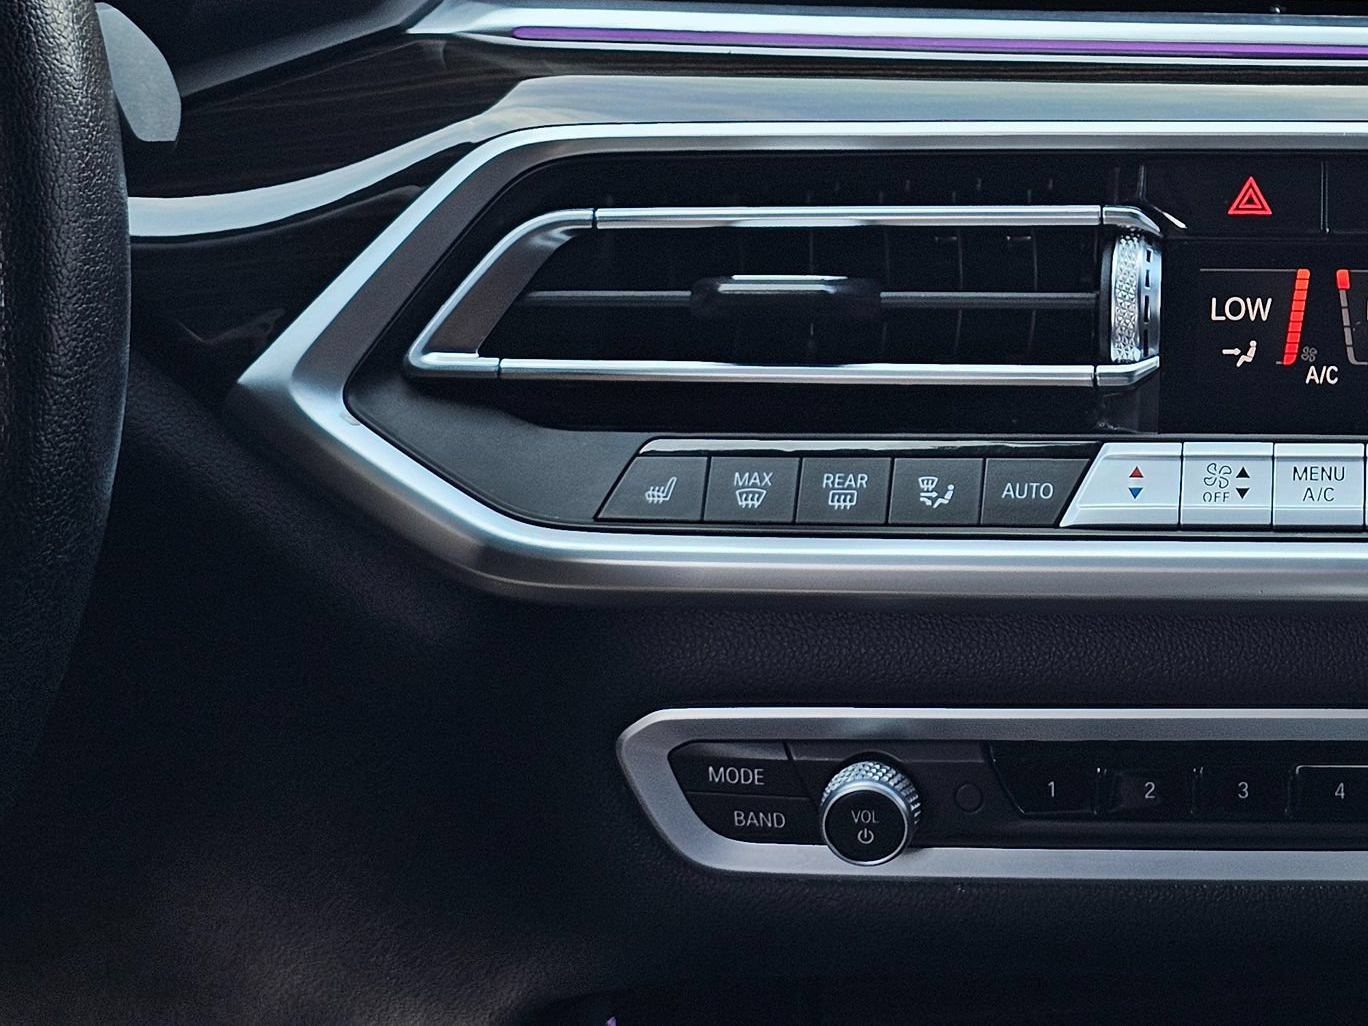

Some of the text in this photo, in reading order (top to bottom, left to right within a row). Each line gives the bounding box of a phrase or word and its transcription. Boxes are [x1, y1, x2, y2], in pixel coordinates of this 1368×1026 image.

[1210, 297, 1272, 322] LOW
[1305, 365, 1339, 385] A/C
[733, 471, 773, 487] MAX
[822, 473, 868, 489] REAR
[1292, 466, 1345, 483] MENU
[1001, 482, 1054, 500] AUTO
[1202, 491, 1230, 504] OFF
[1303, 486, 1335, 504] A/C
[708, 765, 765, 786] MODE
[1144, 781, 1156, 800] 2
[1238, 781, 1249, 800] 3
[1334, 781, 1346, 800] 4
[733, 810, 786, 829] BAND
[851, 809, 880, 824] VOL
